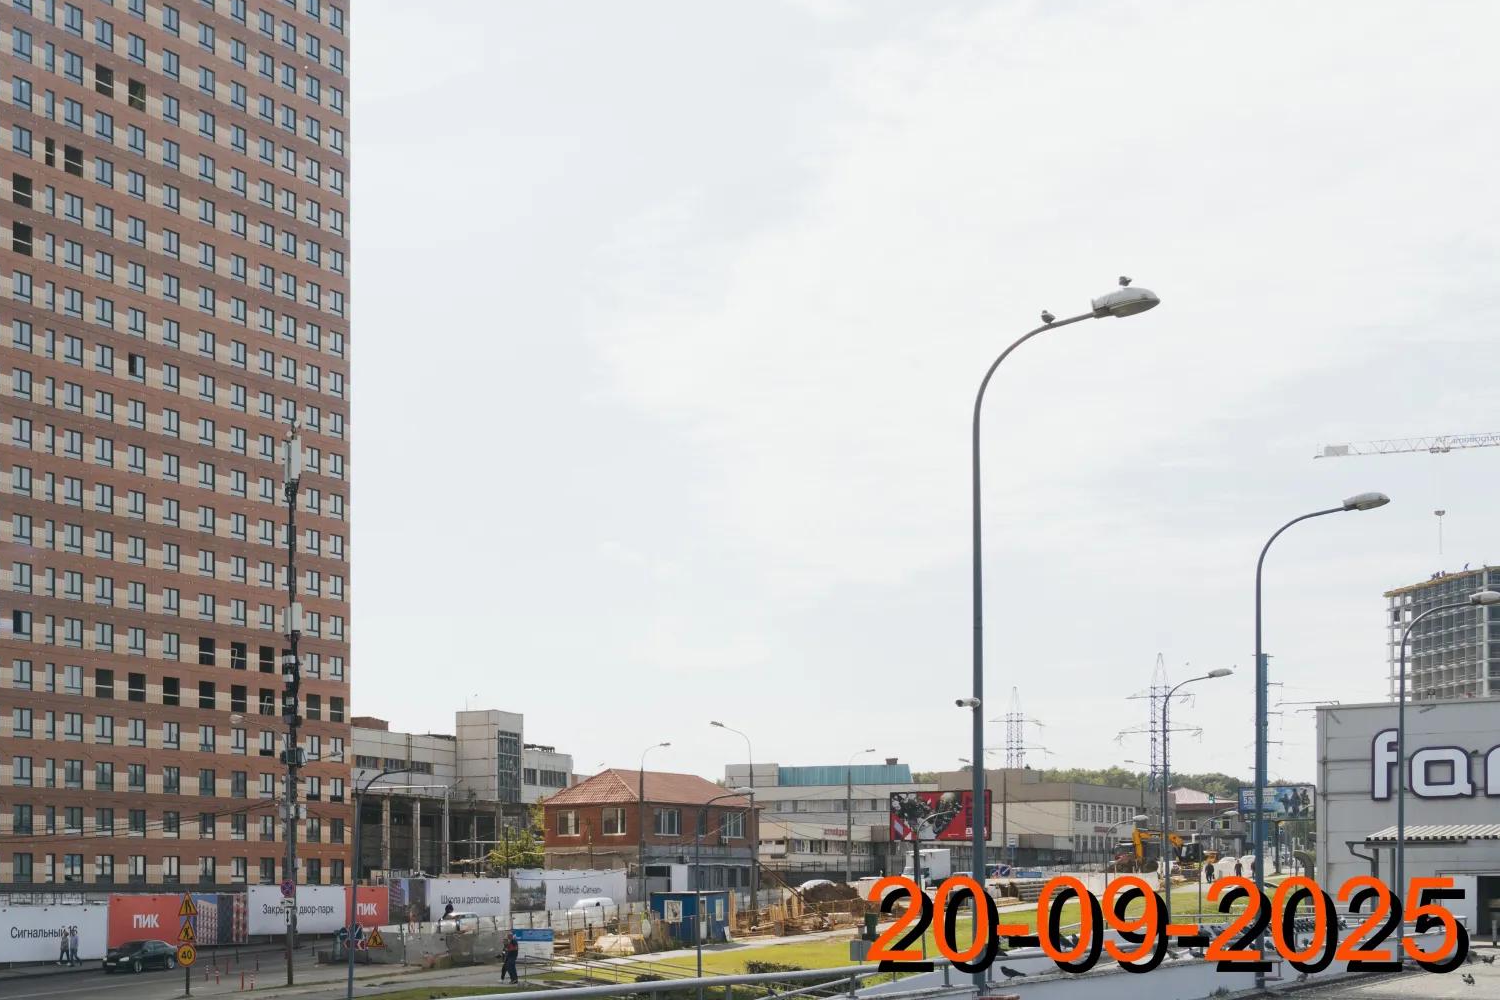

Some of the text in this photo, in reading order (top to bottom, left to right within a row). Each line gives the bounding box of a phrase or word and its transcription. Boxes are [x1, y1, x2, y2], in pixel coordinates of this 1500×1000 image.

[466, 894, 490, 905] детский
[490, 896, 500, 904] сад
[298, 904, 334, 916] двор-парк
[356, 902, 378, 916] ПИК
[133, 914, 159, 928] ПИК
[10, 926, 66, 939] Сигнальный
[181, 950, 192, 960] 40
